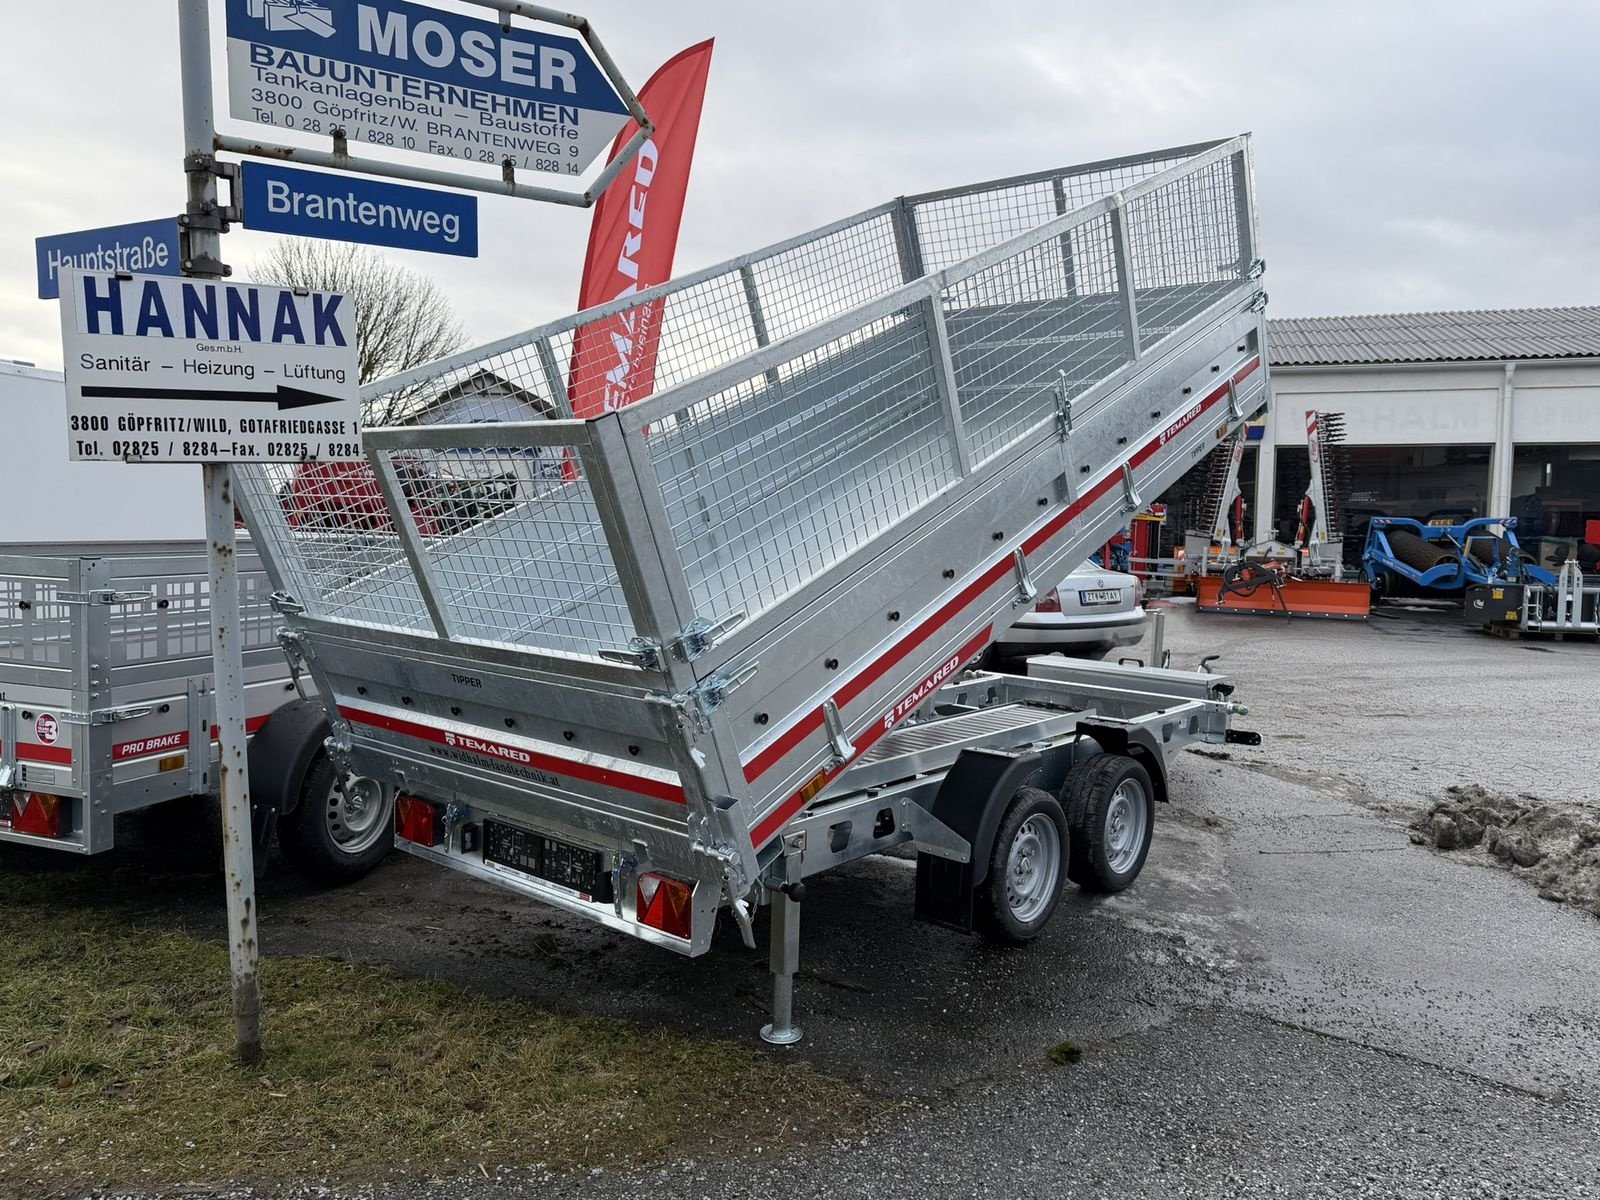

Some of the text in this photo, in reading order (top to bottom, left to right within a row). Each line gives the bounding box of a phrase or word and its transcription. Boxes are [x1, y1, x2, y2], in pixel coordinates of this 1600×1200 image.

[357, 3, 577, 94] MOSER
[250, 43, 580, 126] BAUUNTERNEHMEN
[250, 65, 443, 118] Tankanlagenbau
[480, 112, 579, 141] Baustoffe
[251, 88, 579, 158] 3800 Göpfritz/W. BRANTENWEG 9
[252, 107, 277, 125] Tel.
[285, 114, 295, 128] 0
[303, 118, 321, 133] 28
[355, 127, 361, 140] /
[368, 130, 394, 146] 828
[401, 136, 416, 149] 10
[429, 141, 458, 158] Fax.
[464, 148, 473, 159] 0
[479, 150, 494, 163] 28
[524, 157, 529, 168] /
[536, 160, 560, 172] 828
[566, 163, 579, 175] 14
[267, 179, 460, 243] Brantenweg
[48, 236, 169, 280] Hauptstraße
[603, 138, 658, 413] EMARED
[83, 275, 347, 347] HANNAK
[80, 353, 151, 372] Sanitär
[183, 358, 255, 380] Heizung
[284, 363, 346, 383] Lüftung
[196, 343, 243, 354] Ges.m.b.H.
[70, 412, 358, 436] 3800 GÖPFRITZ/WILD, GOTAFRIEDGASSE 1
[1166, 403, 1202, 438] TEMARED
[76, 440, 103, 456] Tel.
[113, 441, 159, 456] 02825
[168, 441, 173, 456] /
[267, 441, 308, 457] 02825
[315, 443, 321, 457] /
[328, 443, 360, 457] 8284
[451, 673, 482, 688] TIPPER
[896, 655, 959, 715] TEMARED
[121, 734, 182, 756] PRO BRAKE
[457, 735, 531, 763] TEMARED
